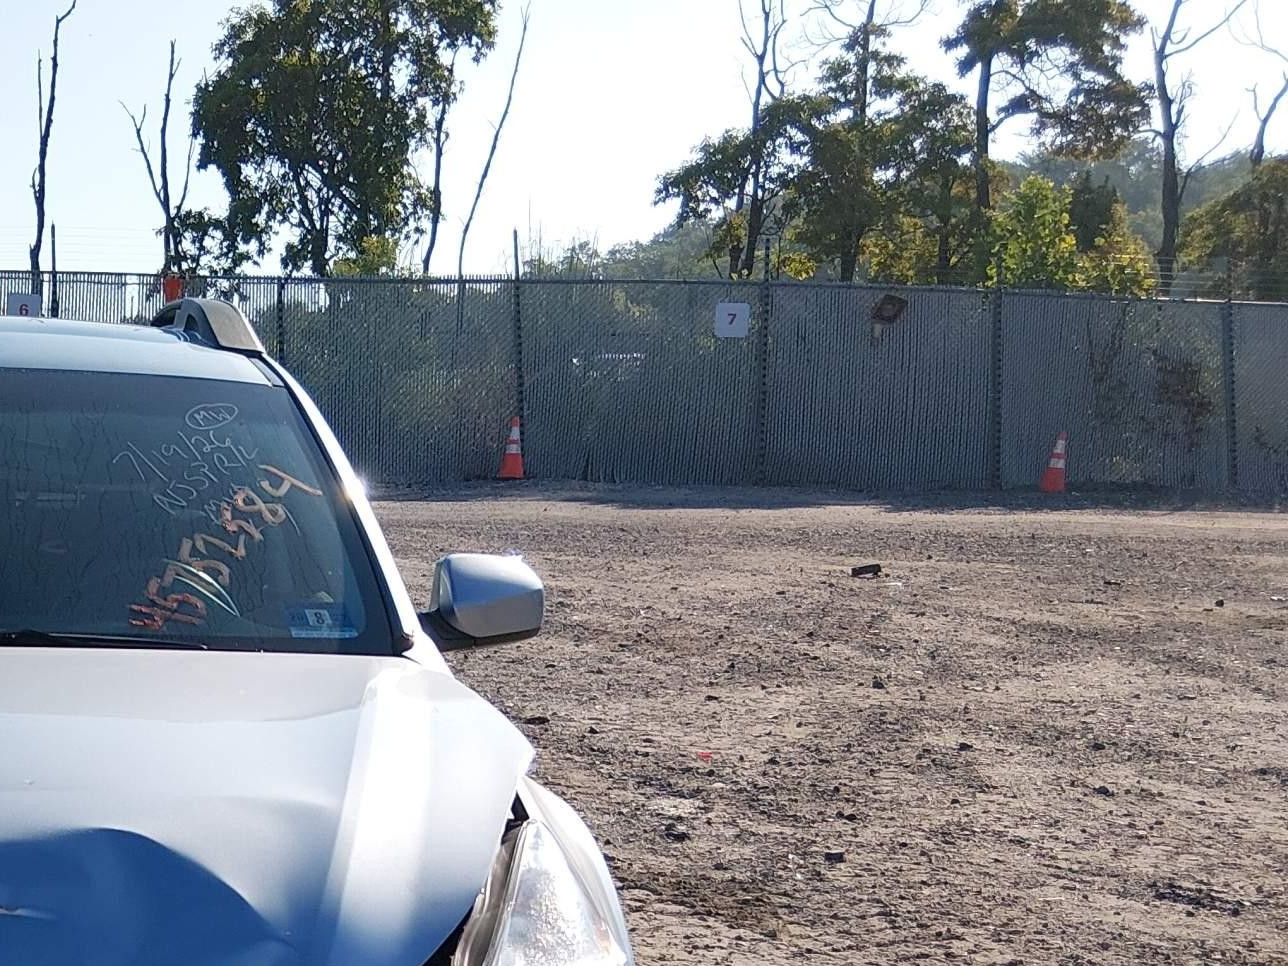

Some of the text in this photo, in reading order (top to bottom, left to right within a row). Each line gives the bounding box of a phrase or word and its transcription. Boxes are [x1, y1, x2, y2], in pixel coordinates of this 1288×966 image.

[19, 303, 29, 316] 6
[727, 313, 737, 325] 7
[128, 464, 323, 632] 45752584
[314, 611, 325, 625] 8
